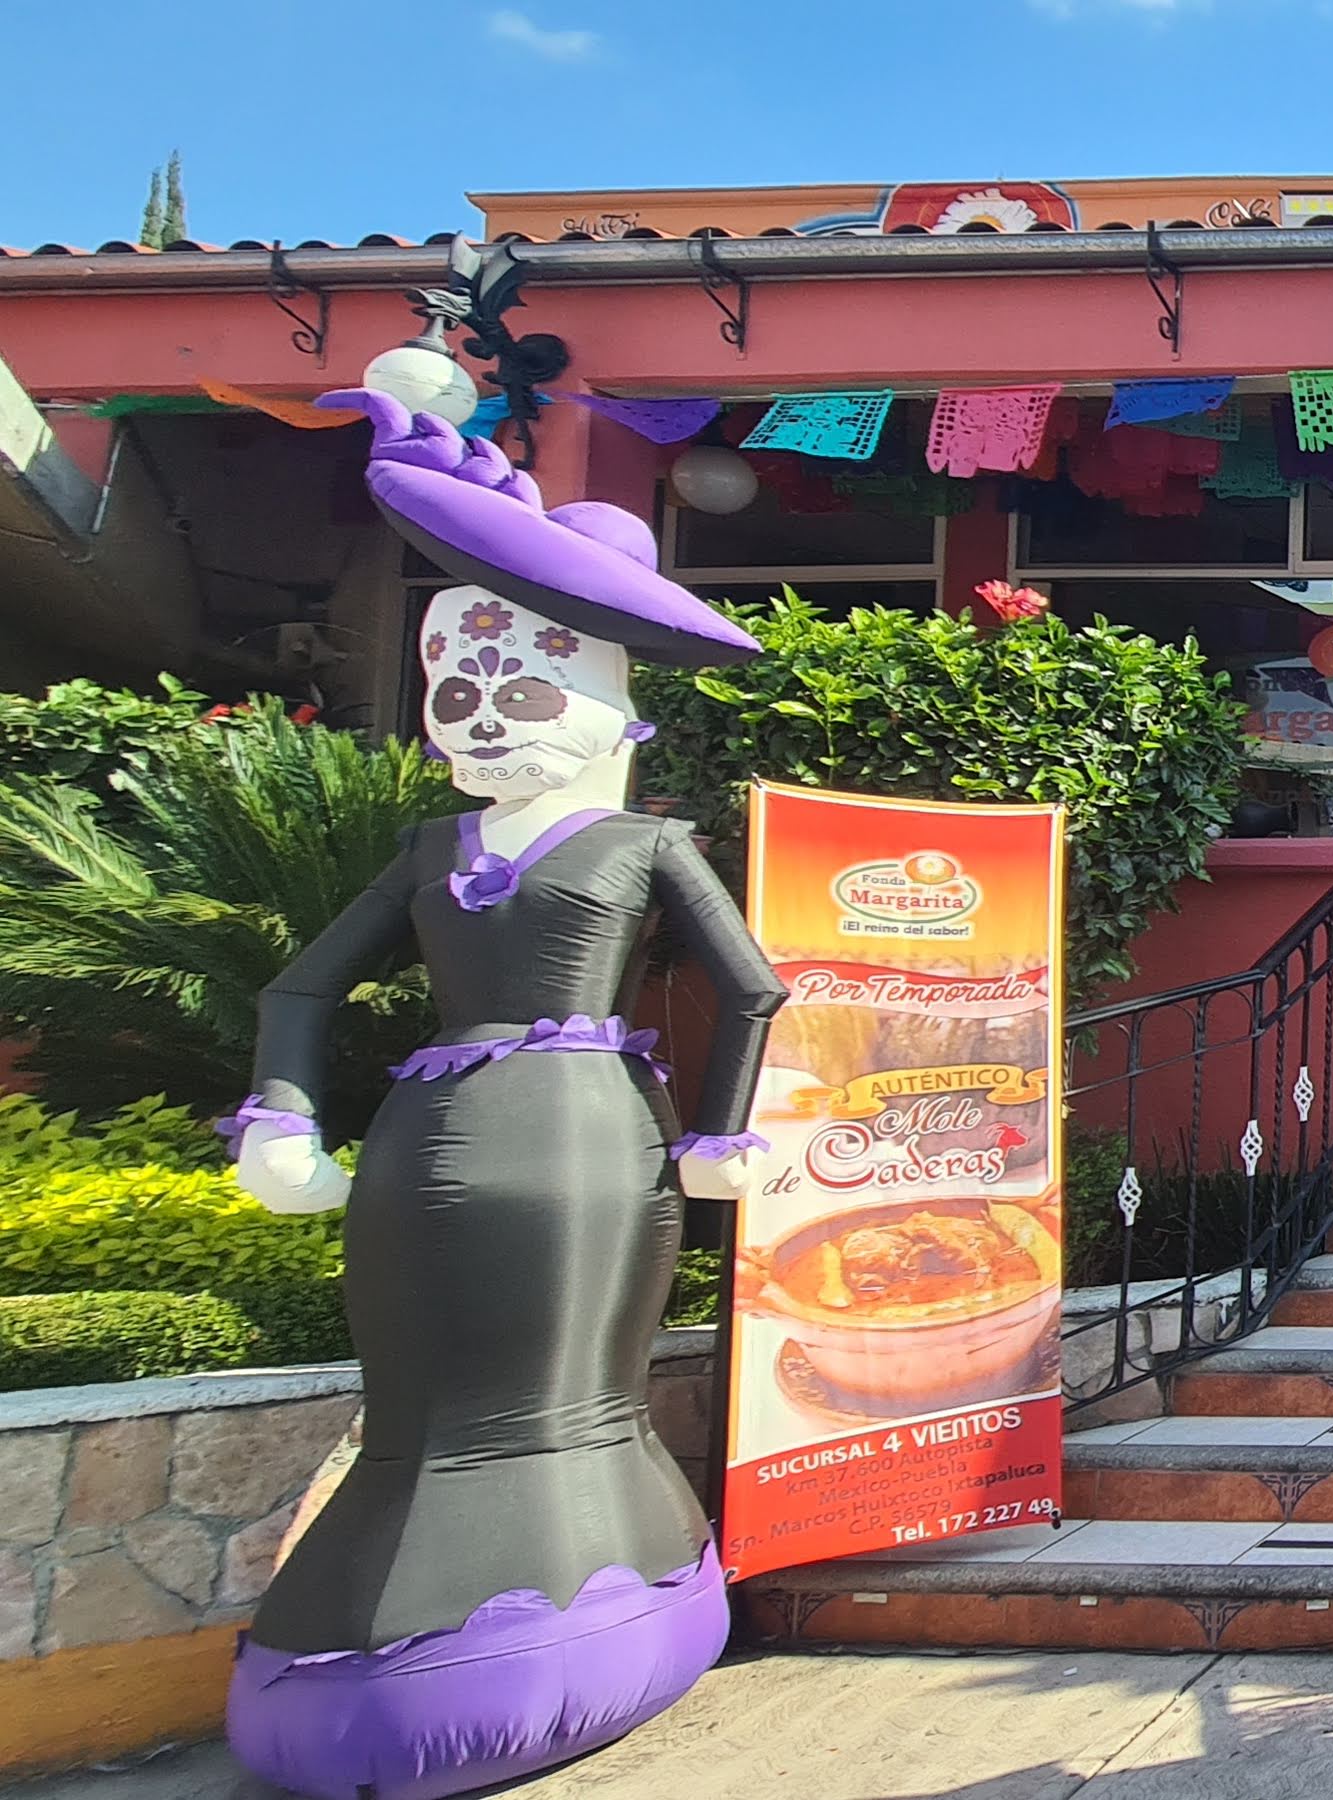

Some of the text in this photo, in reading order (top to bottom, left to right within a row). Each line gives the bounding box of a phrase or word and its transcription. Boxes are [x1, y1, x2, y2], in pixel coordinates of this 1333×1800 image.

[861, 874, 906, 886] Fonda
[849, 889, 965, 911] Margarita
[864, 923, 900, 934] reino
[903, 925, 924, 935] del
[927, 926, 969, 936] sabor!
[798, 971, 1033, 1008] Por Temporada
[870, 1067, 1010, 1098] AUTÉNTICO
[876, 1097, 982, 1137] Mole
[762, 1121, 1007, 1197] de Caderas
[756, 1406, 1023, 1485] SUCURSAL 4 VIENTOS
[785, 1475, 818, 1496] km
[899, 1435, 994, 1468] Autopista
[770, 1508, 847, 1541] Marcos
[851, 1487, 944, 1520] Huixtoco
[947, 1460, 1047, 1493] Ixtapaluca
[890, 1498, 953, 1526] 56579
[891, 1523, 932, 1545] Tel.
[938, 1510, 980, 1536] 172
[982, 1501, 1023, 1525] 227
